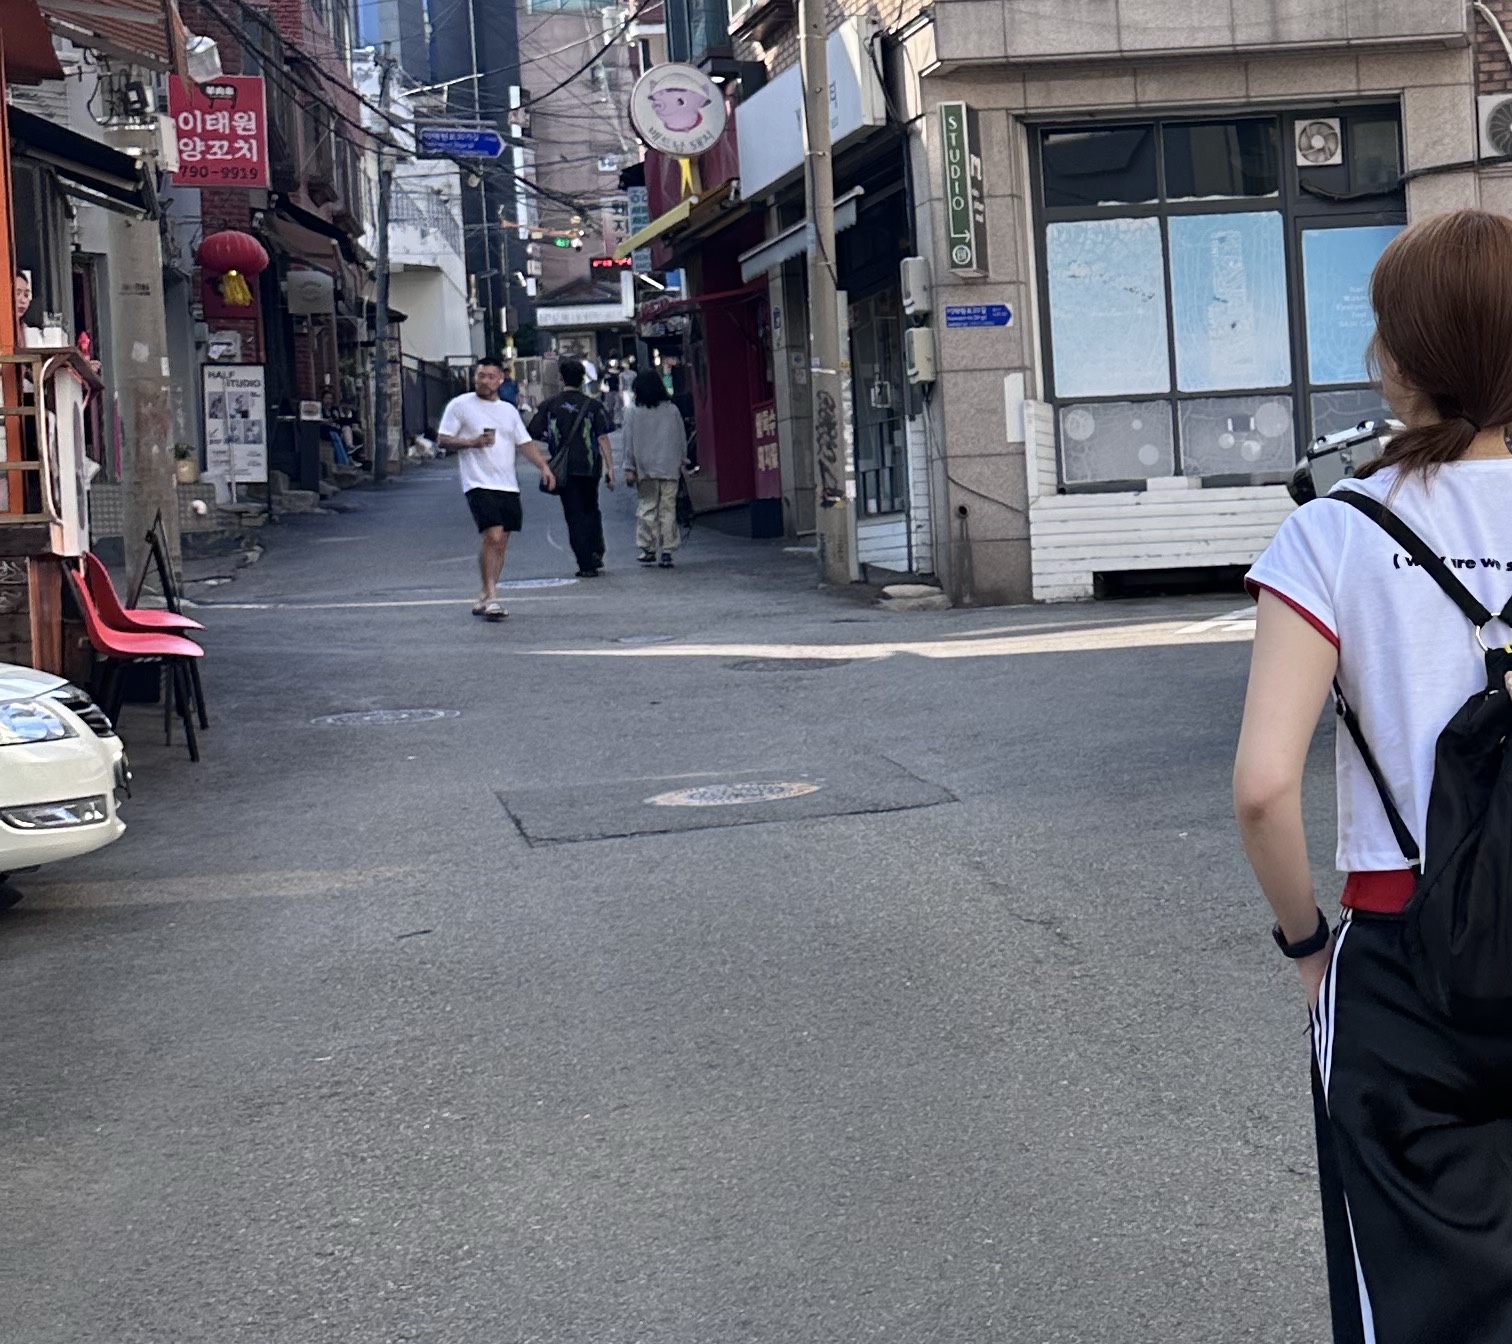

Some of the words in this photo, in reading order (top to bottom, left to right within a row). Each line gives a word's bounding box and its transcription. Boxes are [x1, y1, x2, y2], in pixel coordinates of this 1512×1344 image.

[178, 109, 257, 136] 이태원
[178, 136, 258, 163] 양꼬치
[947, 116, 965, 211] STUDIO
